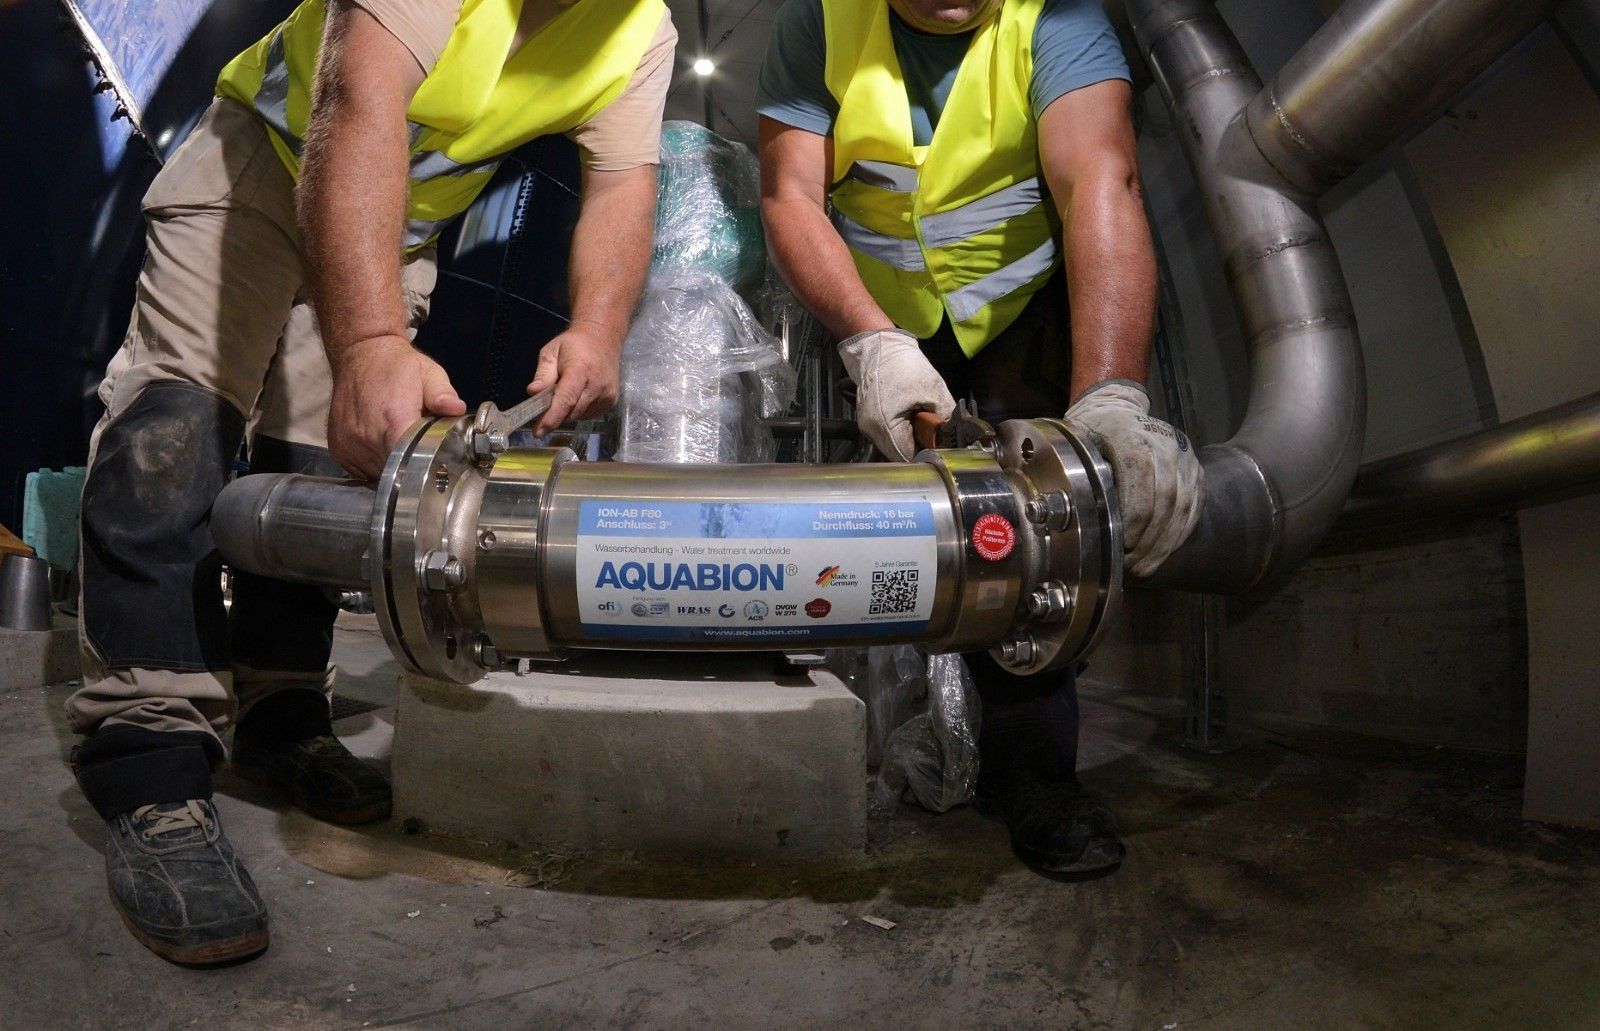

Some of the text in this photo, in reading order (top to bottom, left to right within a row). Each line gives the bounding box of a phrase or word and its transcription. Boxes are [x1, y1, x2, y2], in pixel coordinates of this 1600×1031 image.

[598, 508, 638, 518] ION-AB
[818, 510, 916, 520] Nenndruck: 16 bar
[596, 518, 657, 530] Anschluss:
[812, 520, 874, 531] Durchfluss:
[876, 520, 890, 530] 40
[595, 543, 674, 556] Wasserbehandlung
[681, 546, 706, 555] Water
[707, 546, 747, 555] treatment
[748, 546, 791, 555] worldwide
[598, 601, 615, 611] ofi
[677, 606, 711, 615] WRAS
[704, 628, 811, 637] www.aquabion.com
